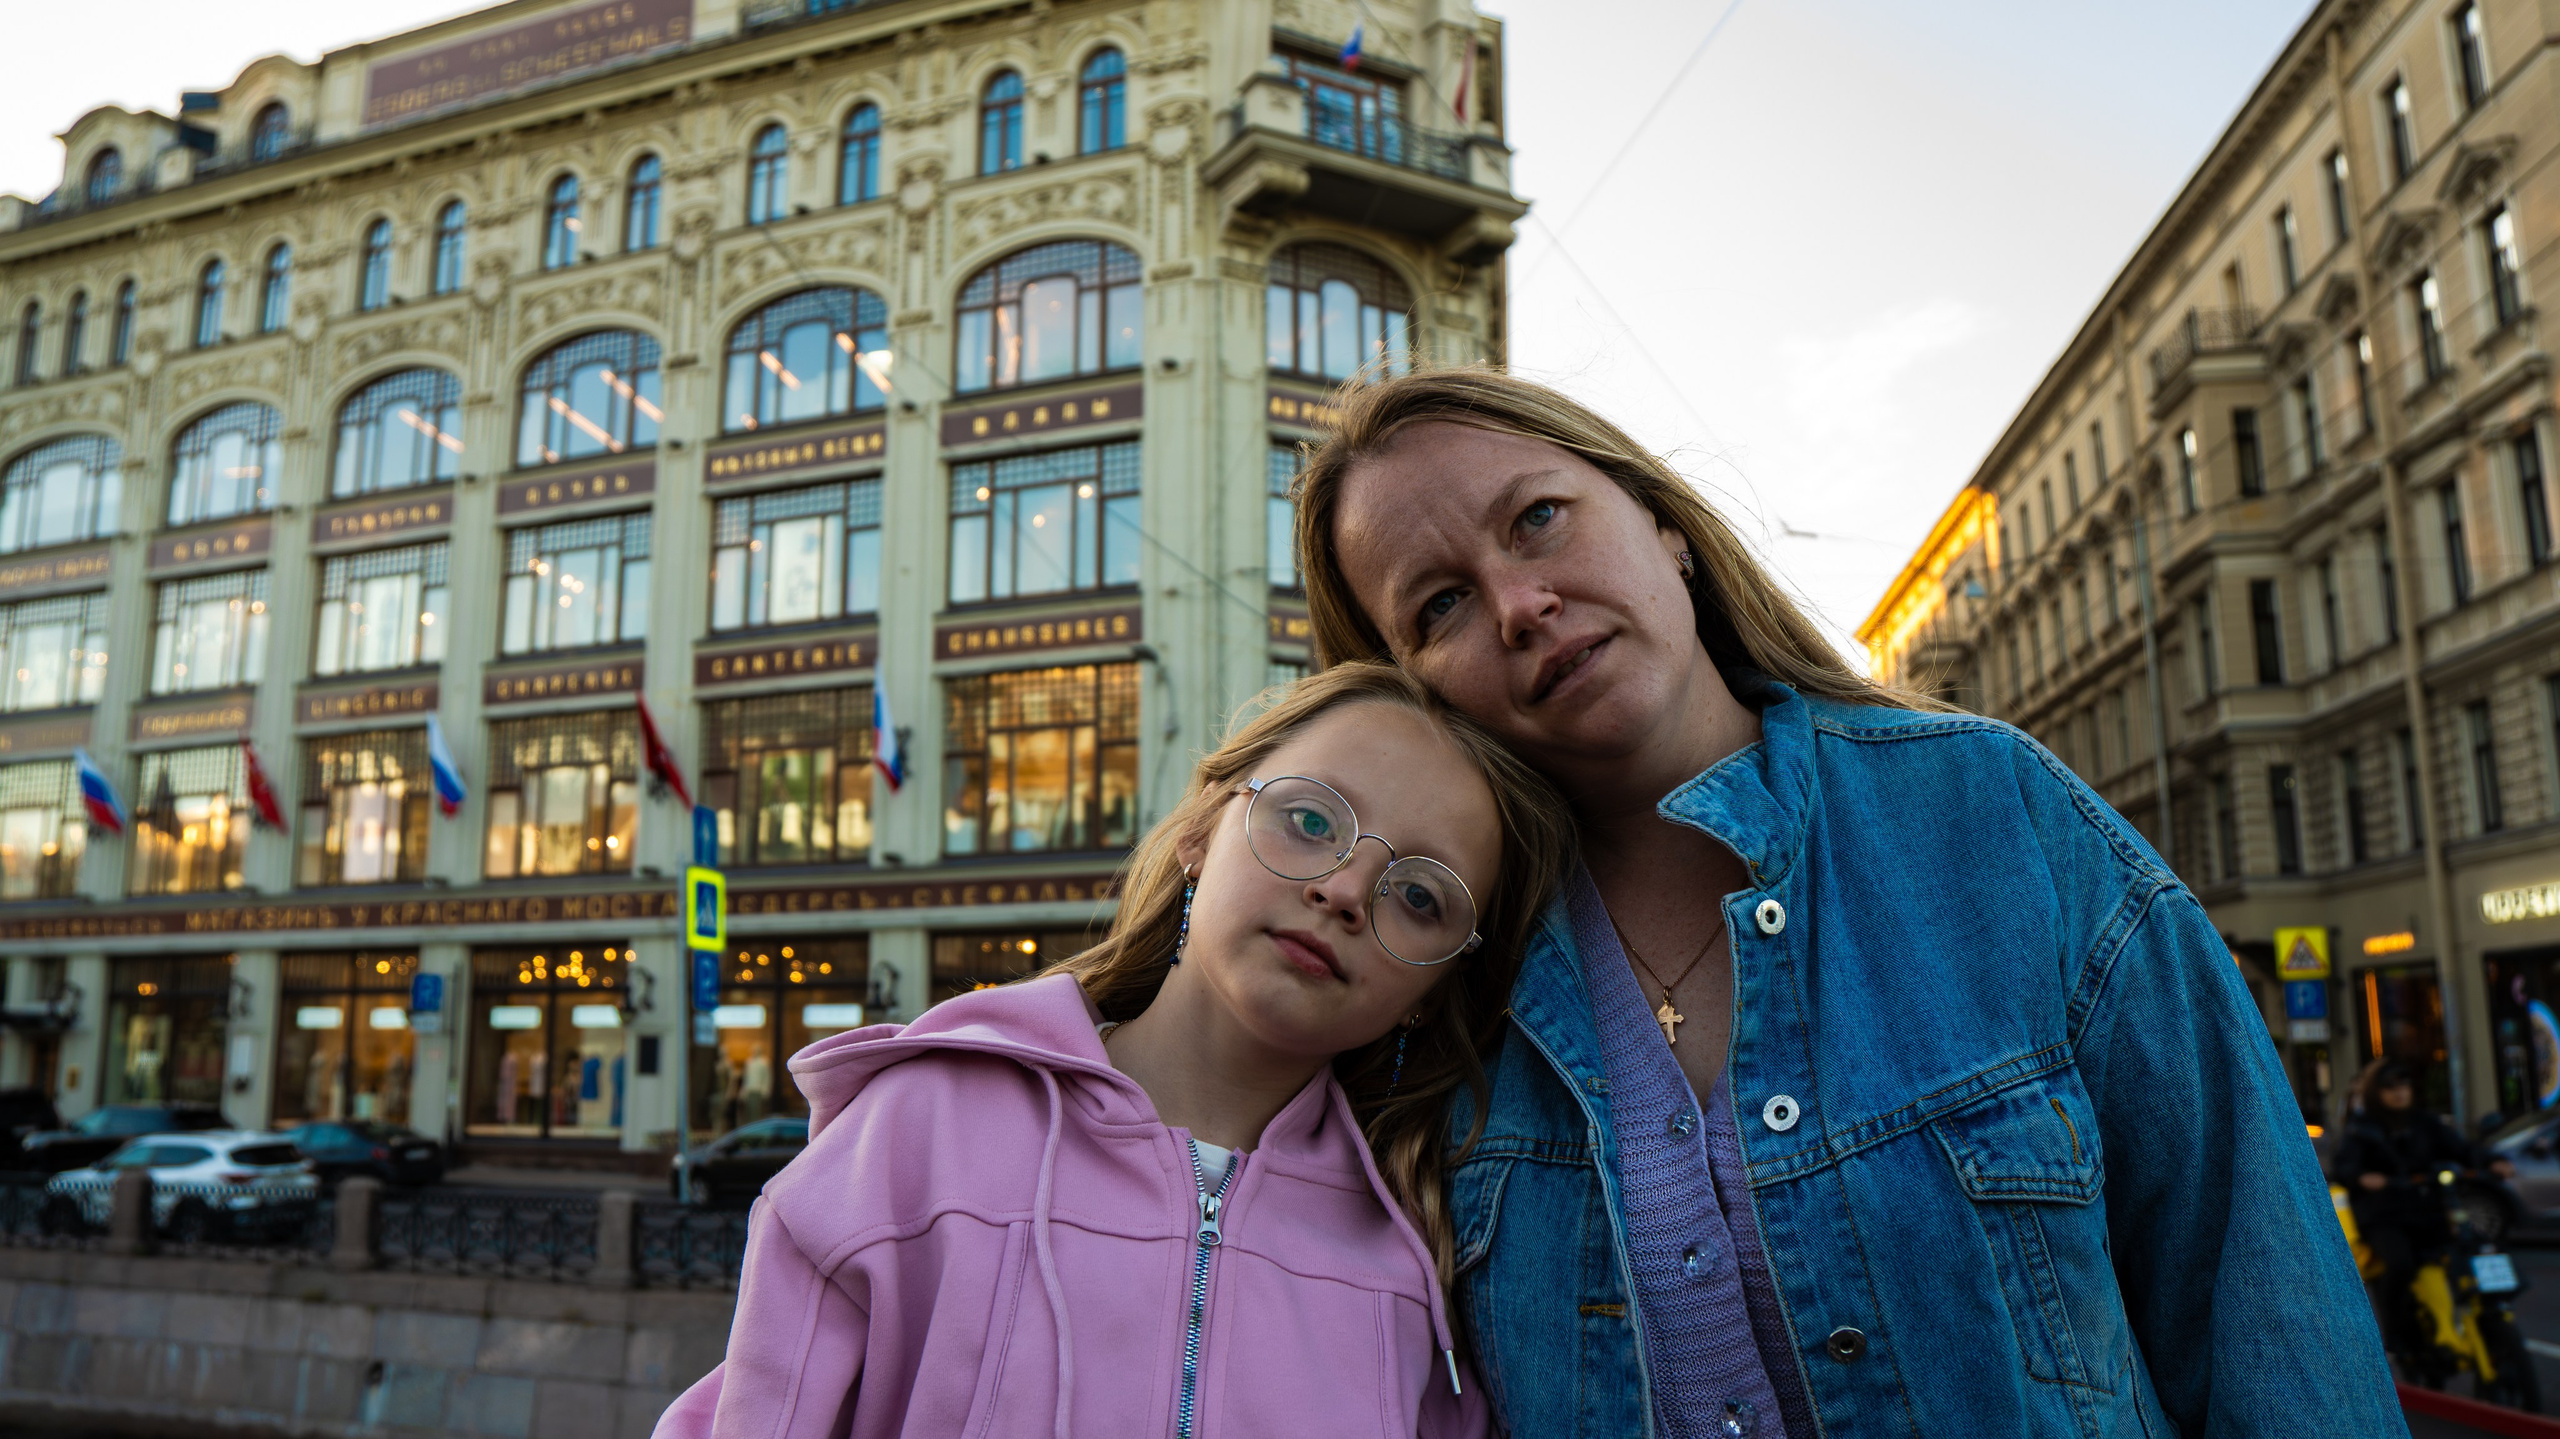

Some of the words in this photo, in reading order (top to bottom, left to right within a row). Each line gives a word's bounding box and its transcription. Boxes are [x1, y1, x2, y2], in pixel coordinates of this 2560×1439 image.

[947, 614, 1131, 653] CHAUSSURES
[710, 641, 863, 680] GANTERIE
[496, 666, 635, 702] CHAPEAUX
[184, 905, 339, 932] МАГАЗИНЪ
[351, 905, 370, 928] У
[380, 896, 549, 926] КРАСНАГО
[563, 892, 678, 918] МОСТА
